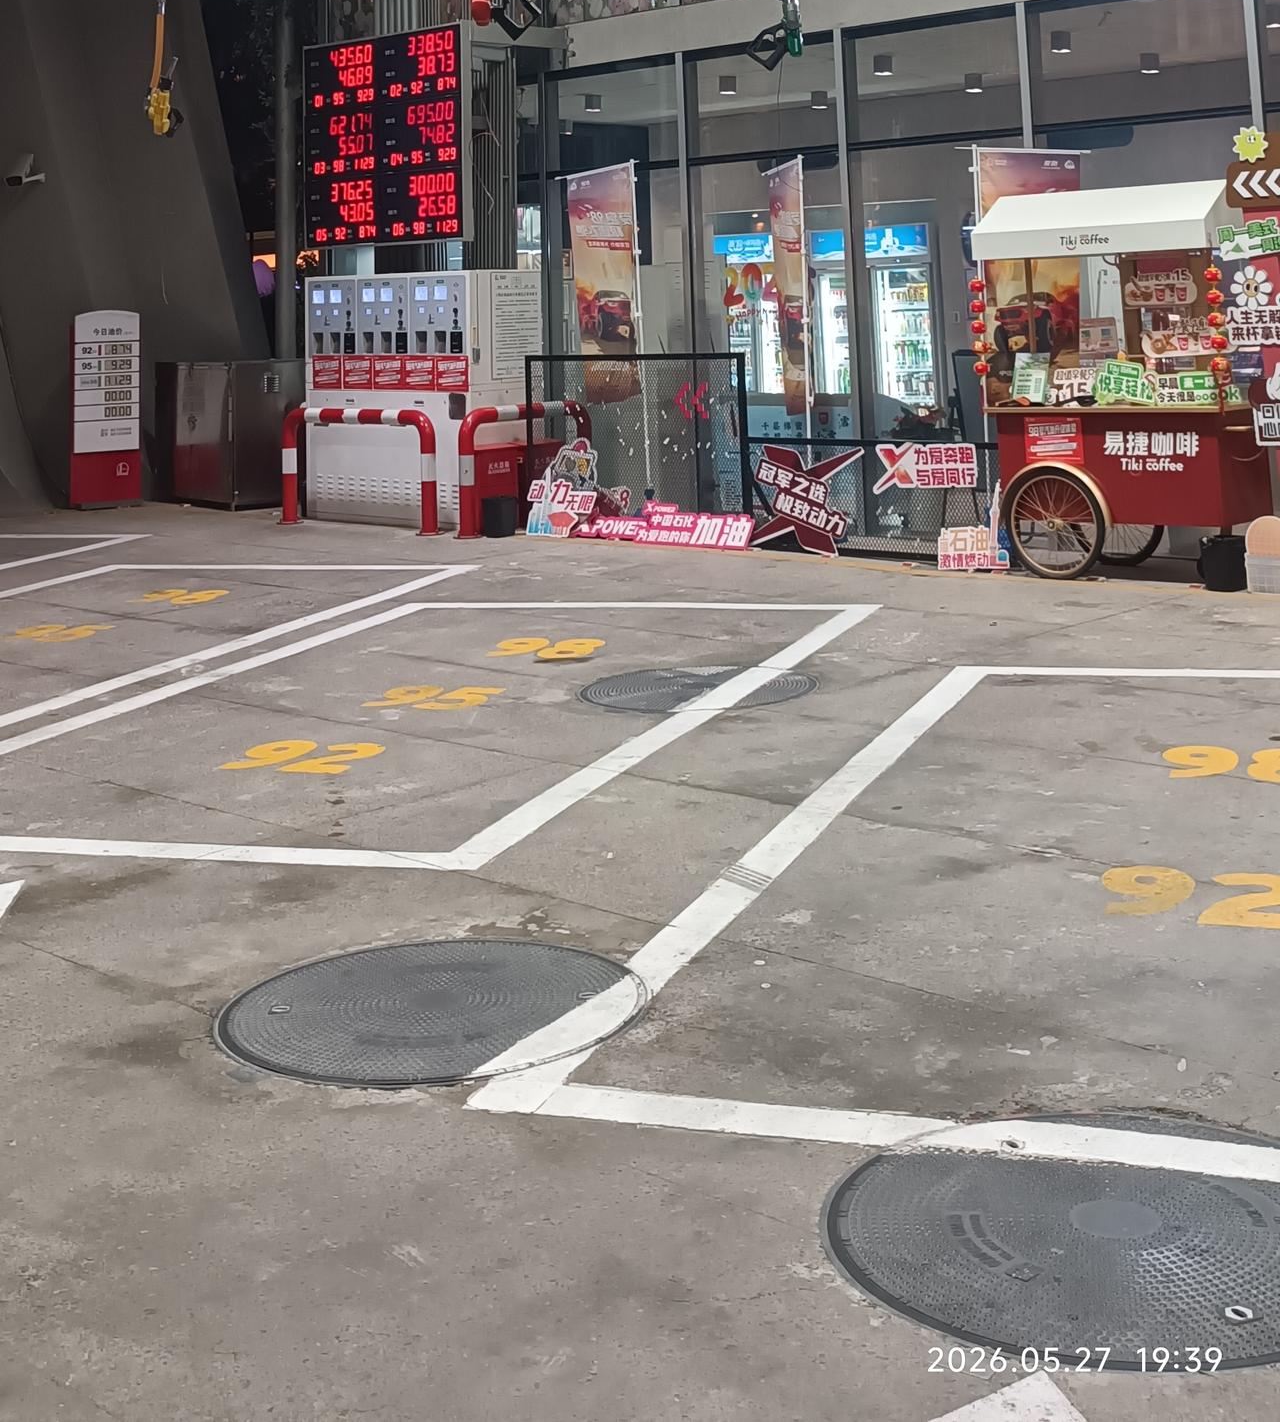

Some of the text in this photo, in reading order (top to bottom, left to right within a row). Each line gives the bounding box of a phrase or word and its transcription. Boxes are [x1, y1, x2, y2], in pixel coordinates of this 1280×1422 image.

[390, 84, 401, 96] 02
[411, 82, 422, 94] 92
[314, 95, 323, 107] 01
[333, 93, 344, 105] 95
[314, 162, 325, 174] 03
[333, 160, 344, 172] 98
[391, 154, 402, 166] 04
[411, 151, 423, 163] 95
[315, 229, 327, 241] 05
[335, 228, 346, 240] 92
[393, 223, 404, 236] 06
[413, 222, 425, 234] 98
[1060, 234, 1110, 246] Tiki coffee
[1248, 236, 1280, 254] 一周
[82, 346, 92, 354] 92
[1103, 431, 1199, 457] 易捷咖啡
[914, 447, 975, 466] 为爱奔跑
[1120, 458, 1184, 472] Tiki coffee
[758, 462, 827, 504] 冠军之选
[916, 468, 977, 486] 与爱同行
[651, 514, 694, 528] 中国石化
[776, 492, 846, 536] 极致动力
[689, 515, 752, 547] 加油
[949, 527, 988, 551] 石油
[486, 637, 607, 660] 98
[361, 684, 506, 710] 95
[217, 739, 387, 774] 92
[1100, 865, 1280, 929] 92
